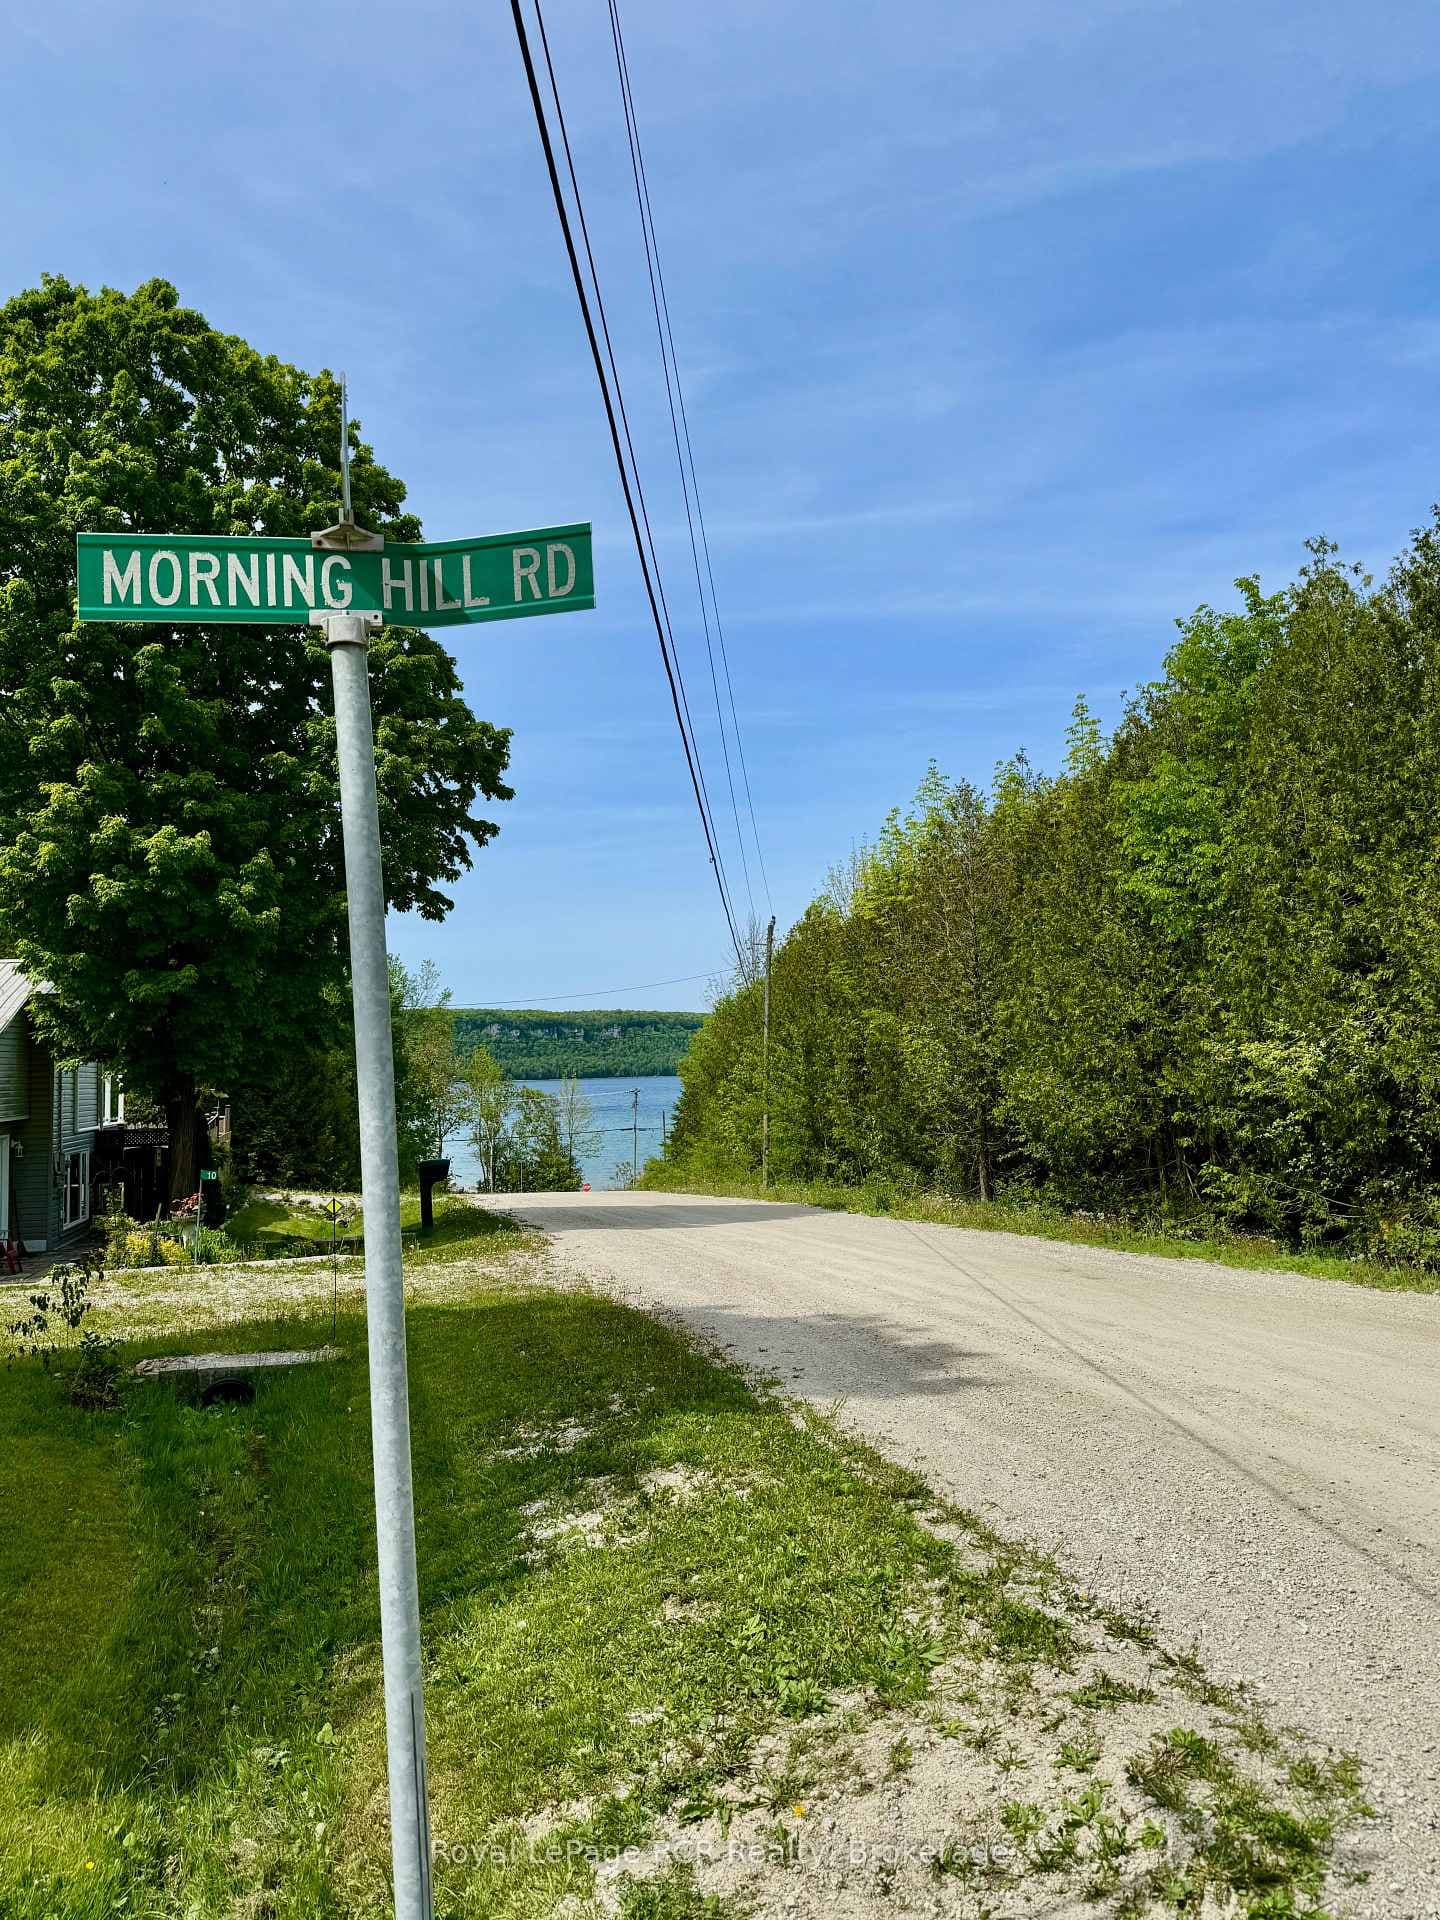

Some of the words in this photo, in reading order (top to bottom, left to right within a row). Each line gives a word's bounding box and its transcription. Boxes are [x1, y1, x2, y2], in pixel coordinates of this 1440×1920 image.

[102, 549, 353, 609] MORNING
[382, 554, 490, 612] HILL
[513, 543, 577, 602] RD
[207, 1171, 216, 1179] 10
